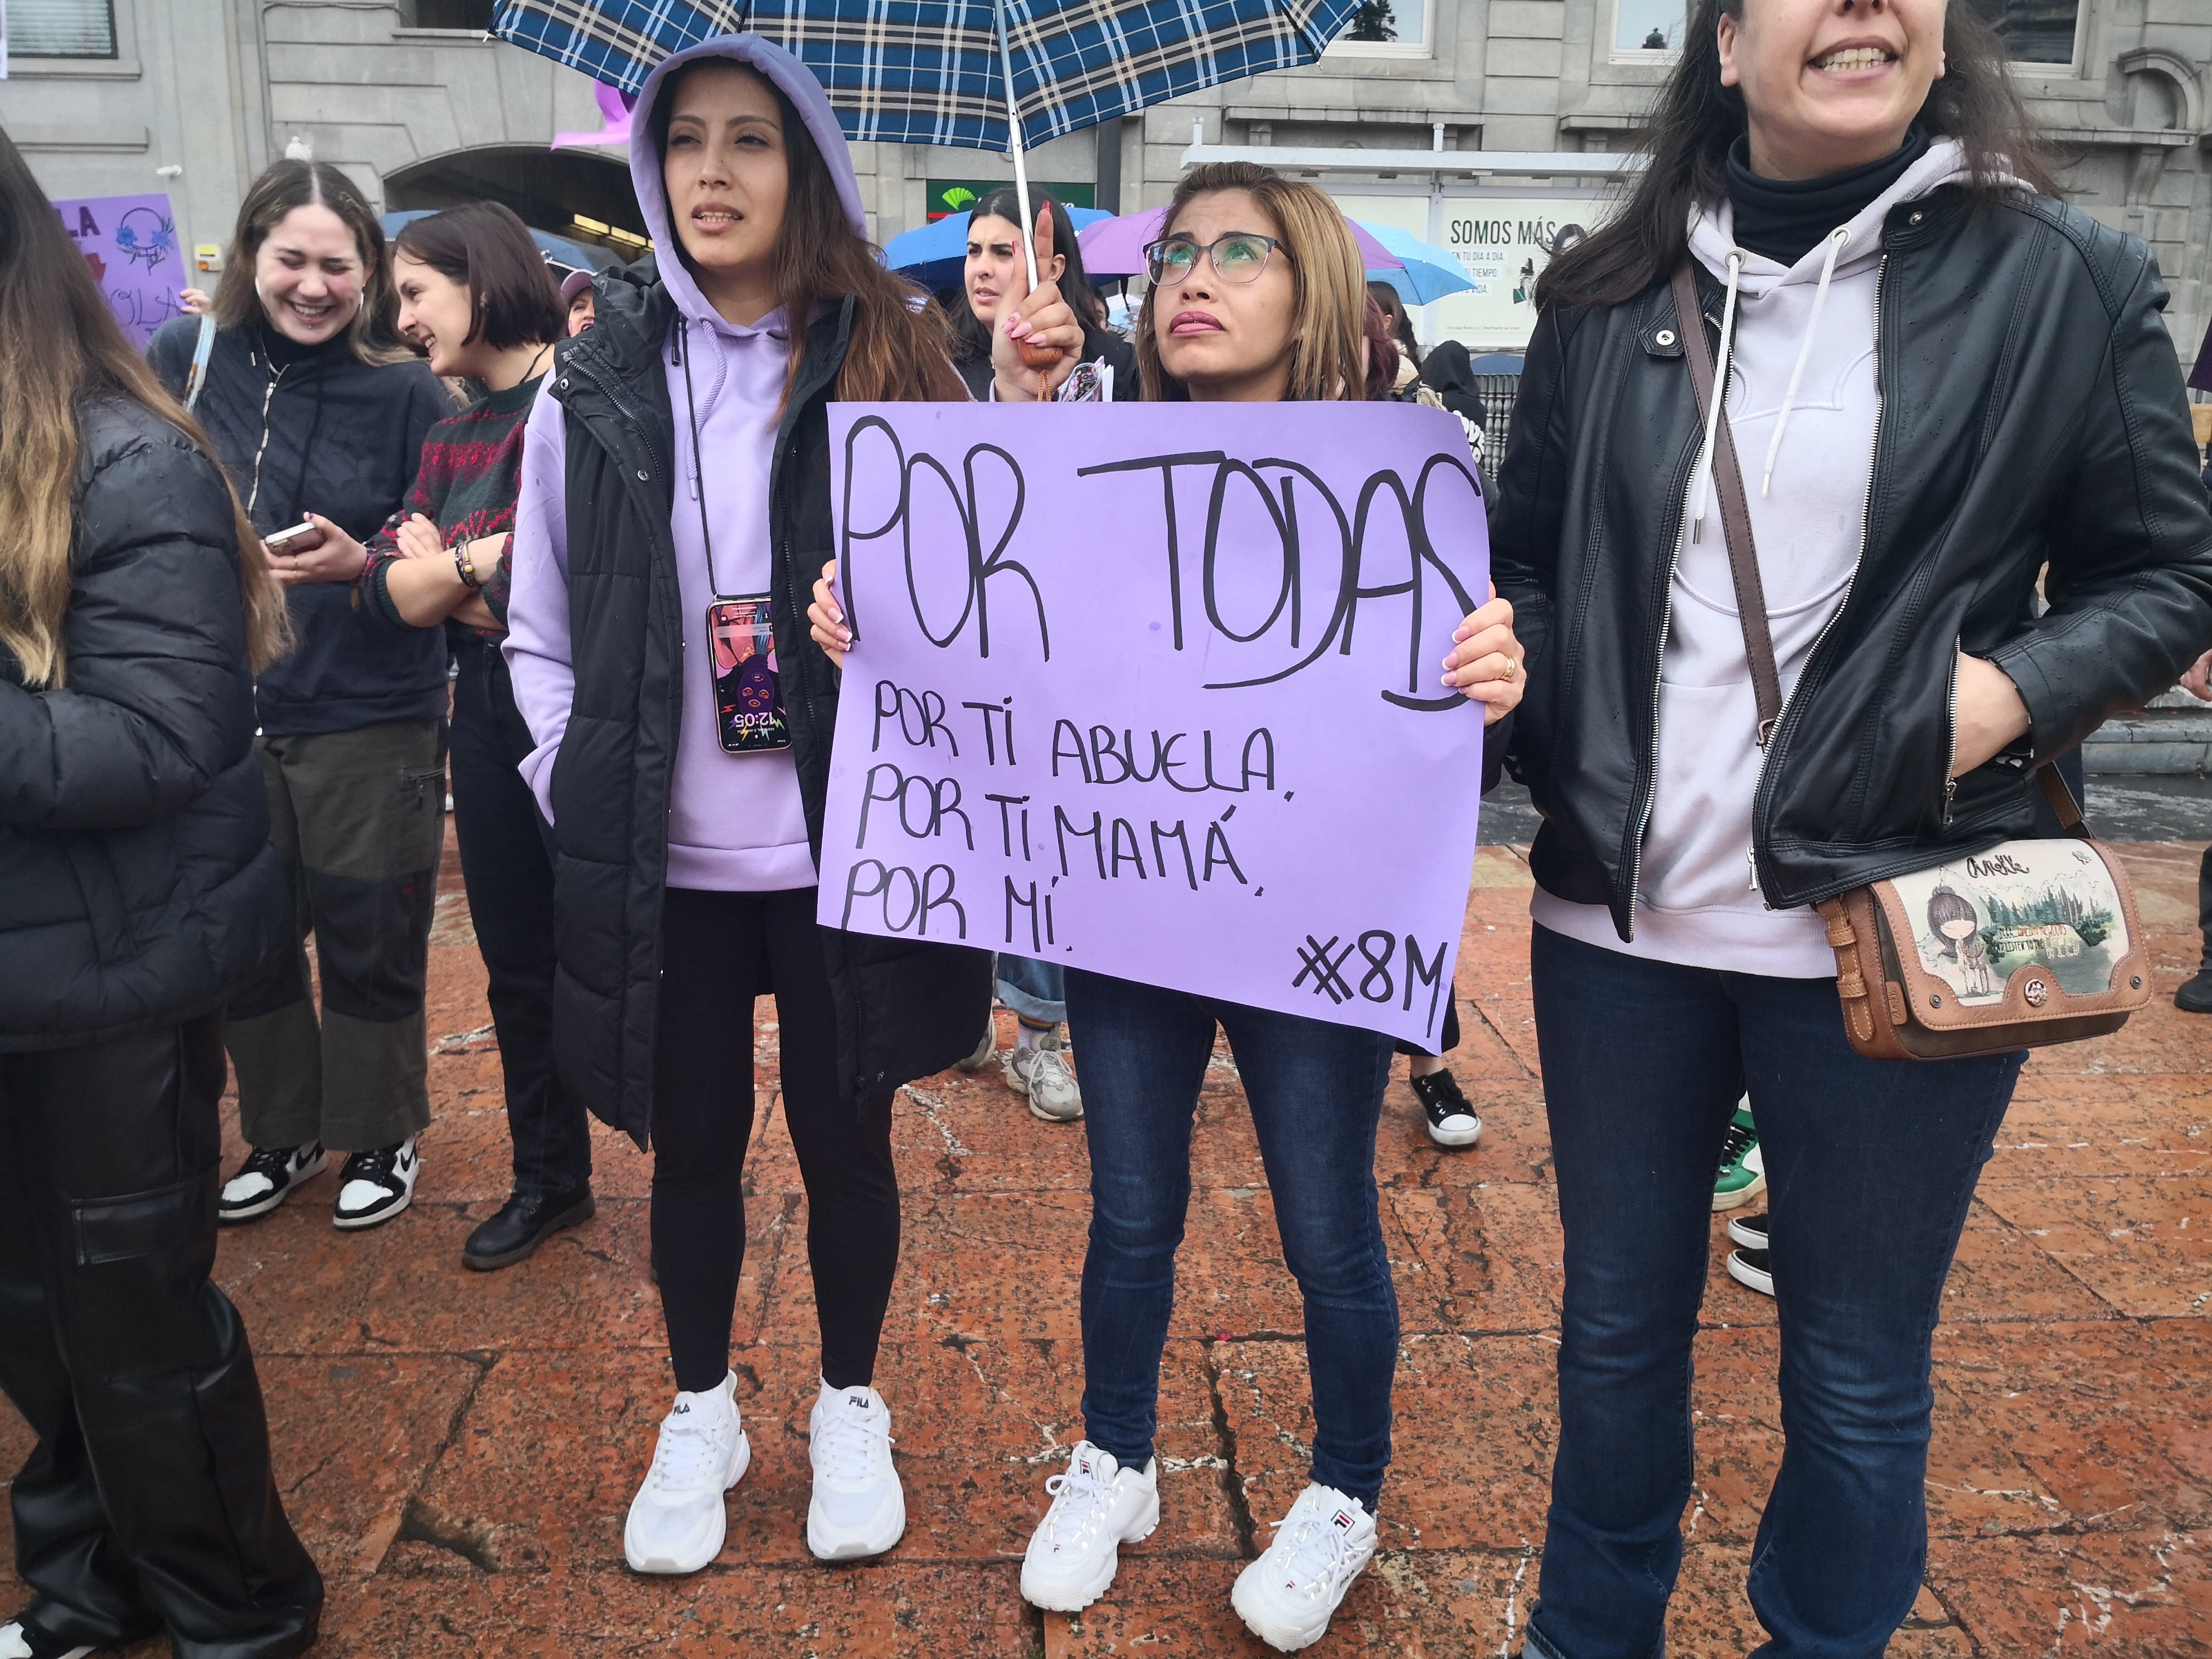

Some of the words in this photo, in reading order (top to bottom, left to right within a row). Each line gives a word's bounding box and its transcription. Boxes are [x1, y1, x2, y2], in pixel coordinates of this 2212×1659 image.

[1451, 220, 1512, 245] SOMOS
[1517, 216, 1556, 245] MÁS
[1462, 251, 1471, 261] TU
[1473, 250, 1483, 261] DÍA
[1486, 251, 1491, 260] A
[841, 414, 1050, 663] POR
[1076, 449, 1483, 712] TODAS
[734, 711, 774, 728] 12:05
[872, 679, 959, 757] POR
[855, 763, 974, 850] POR
[841, 859, 966, 939] POR
[1291, 929, 1448, 1039] #8M
[673, 1401, 691, 1417] FILA
[848, 1395, 869, 1409] FILA
